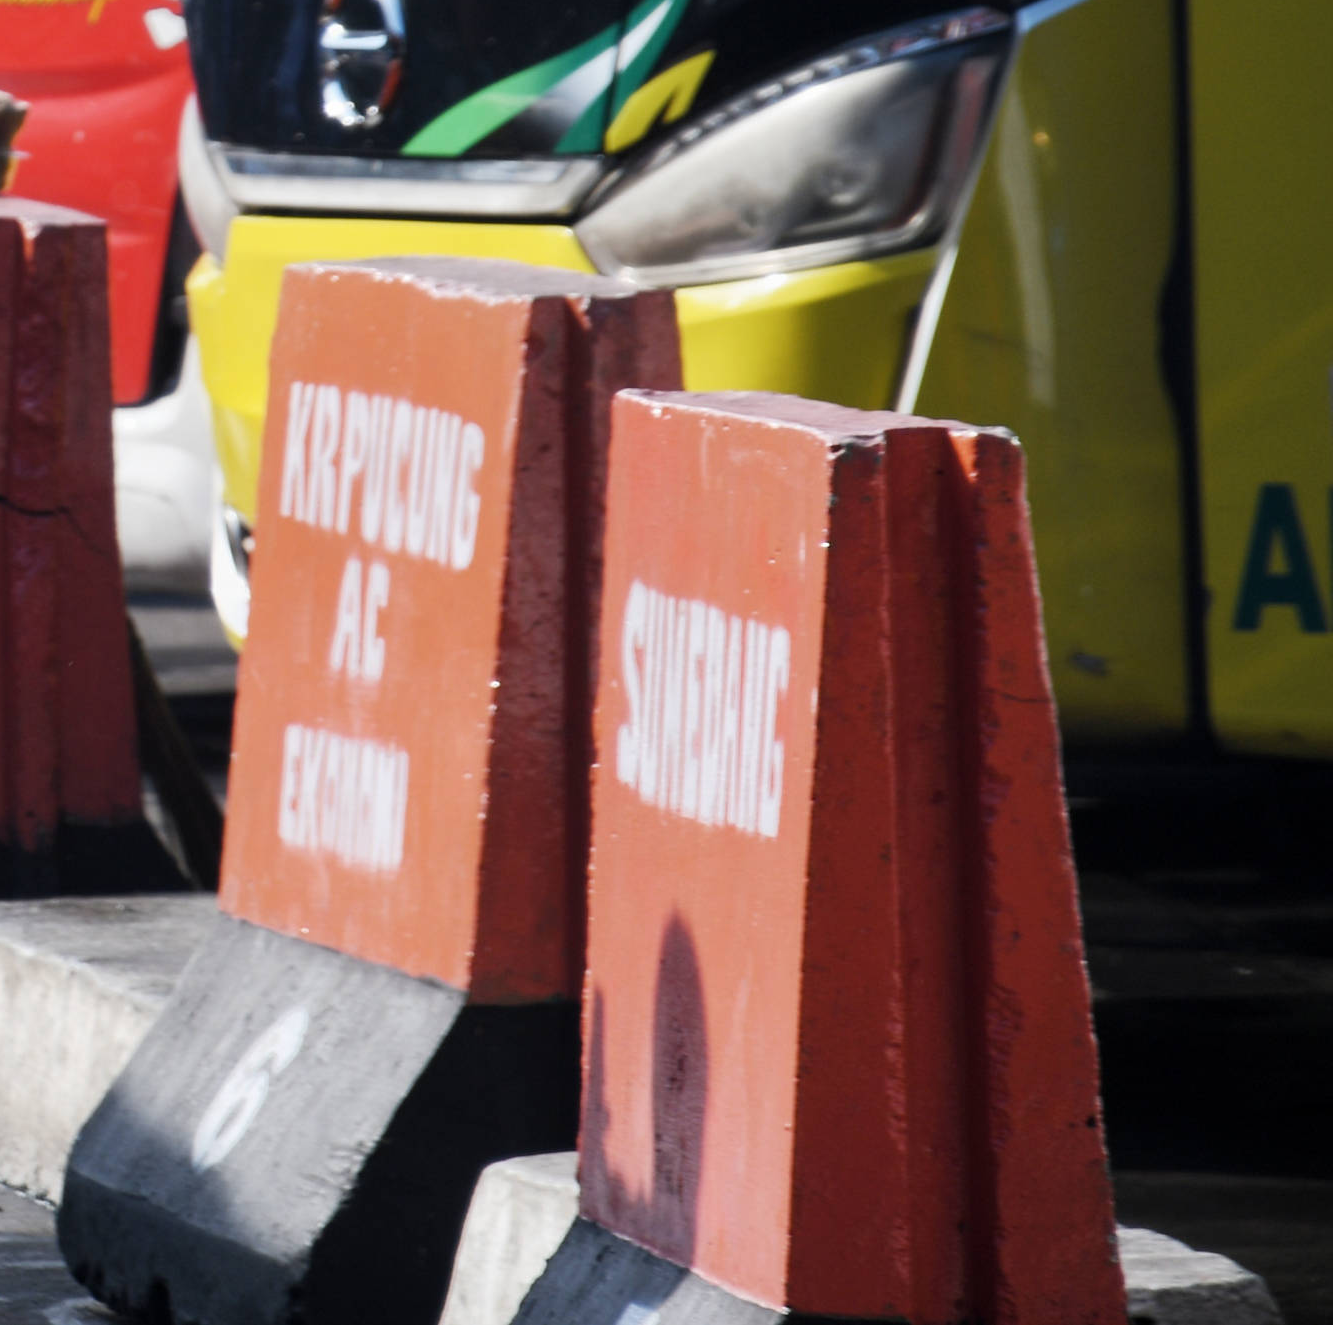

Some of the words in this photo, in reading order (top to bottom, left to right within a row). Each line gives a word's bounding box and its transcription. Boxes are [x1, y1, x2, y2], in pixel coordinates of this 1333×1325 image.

[330, 556, 391, 680] AC
[1231, 482, 1333, 635] A
[616, 576, 792, 839] SUMEDANG
